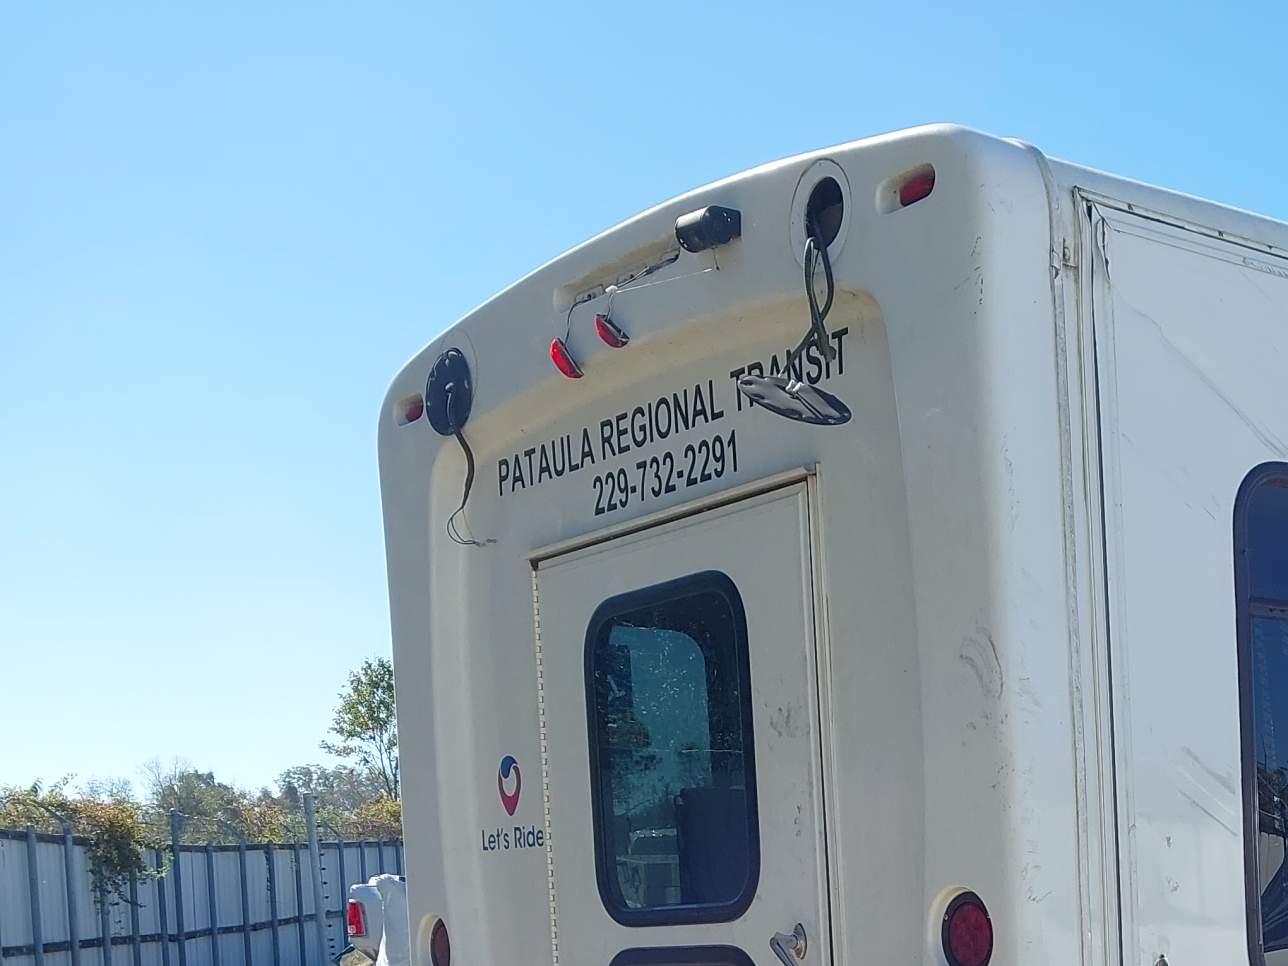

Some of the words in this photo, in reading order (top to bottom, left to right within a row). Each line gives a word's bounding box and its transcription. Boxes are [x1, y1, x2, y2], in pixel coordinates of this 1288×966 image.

[498, 427, 596, 497] PATAULA
[600, 380, 725, 461] REGIONAL
[592, 429, 738, 517] 229-732-2291
[481, 827, 510, 851] Let's
[513, 825, 545, 849] Ride
